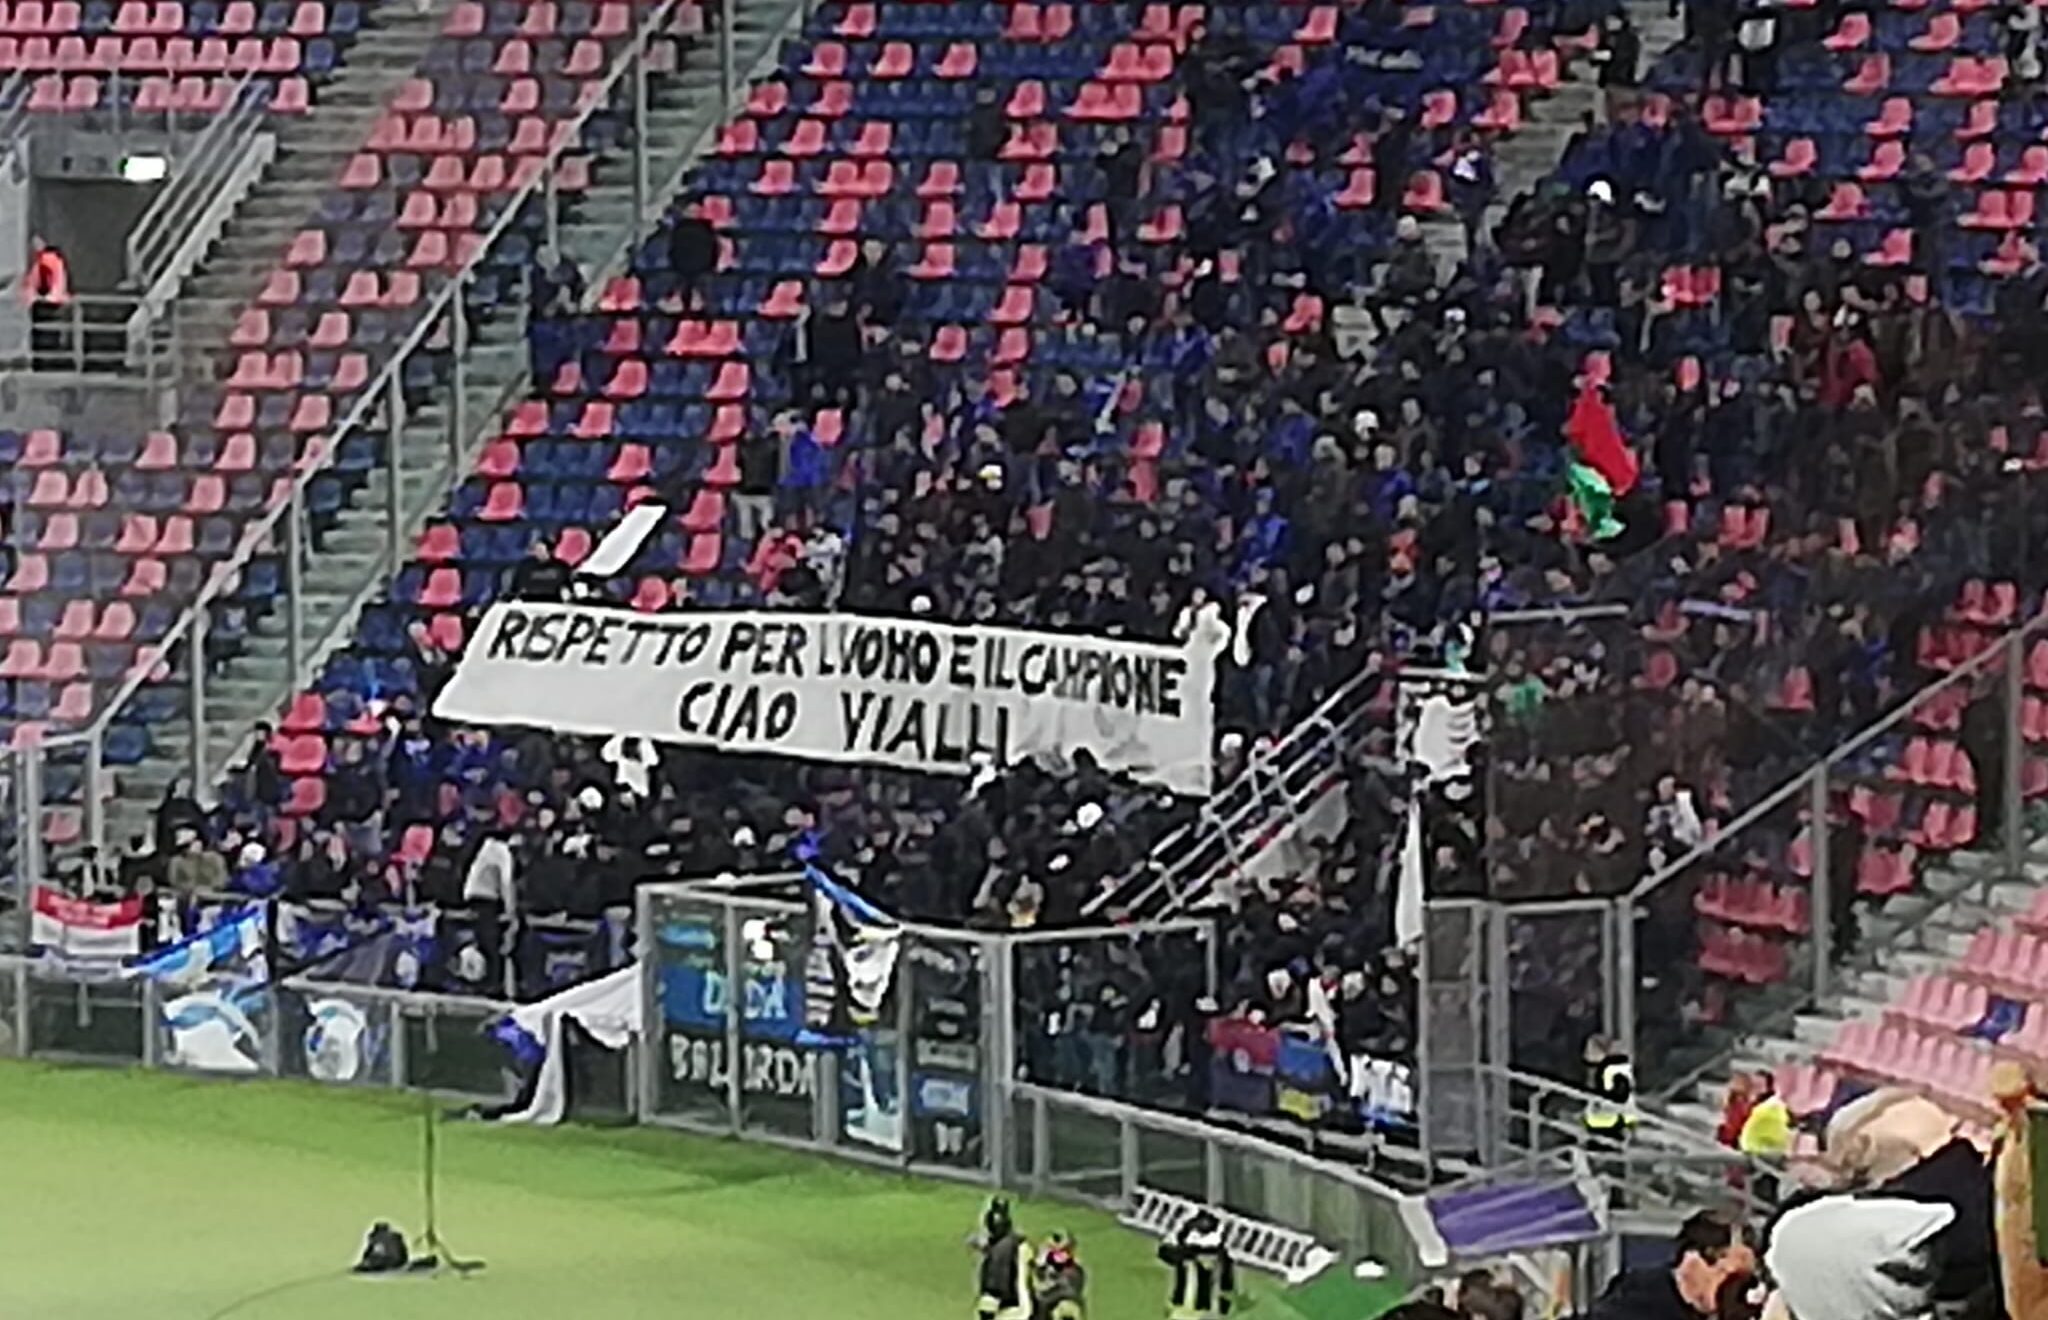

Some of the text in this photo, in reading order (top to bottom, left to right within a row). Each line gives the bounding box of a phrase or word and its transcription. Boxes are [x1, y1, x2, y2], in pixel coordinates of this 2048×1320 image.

[487, 609, 712, 666] RISPETTO
[719, 622, 808, 678] PER
[948, 633, 978, 690] E
[984, 636, 1015, 690] IL
[1018, 643, 1188, 718] CAMPIONE
[678, 680, 1010, 769] CIAO VIALLI
